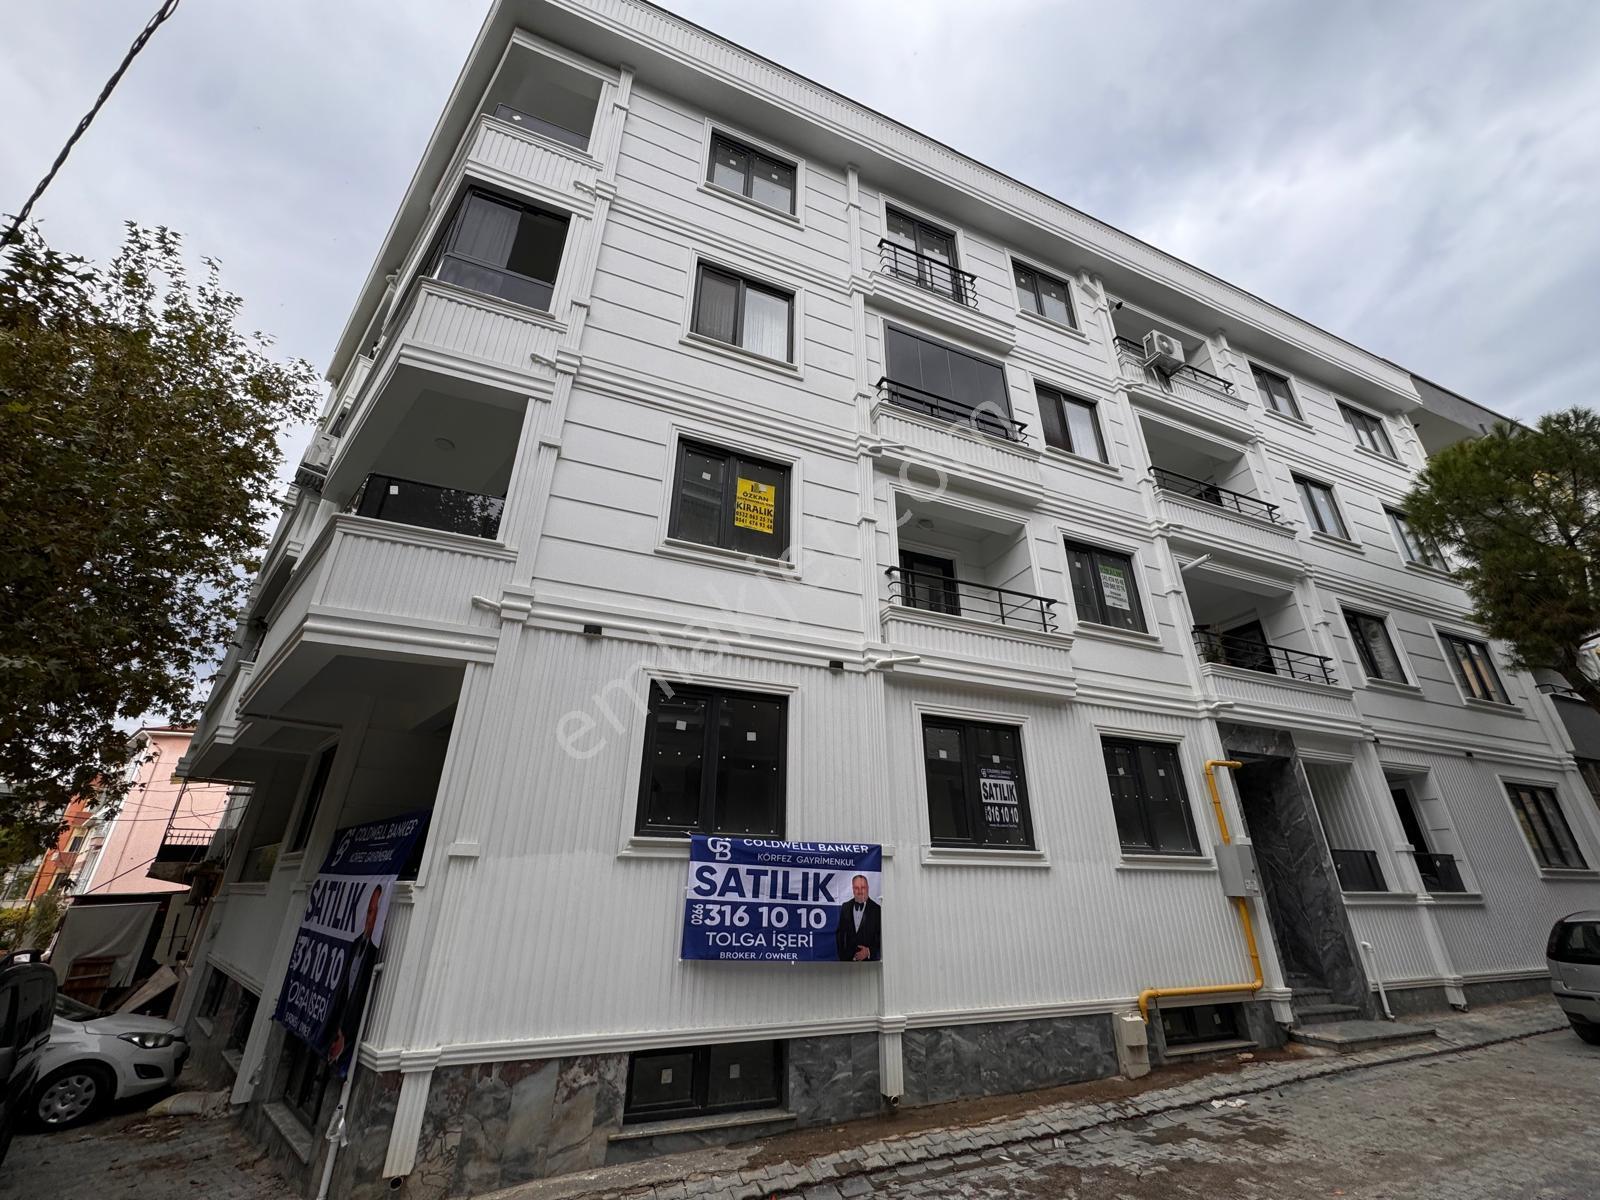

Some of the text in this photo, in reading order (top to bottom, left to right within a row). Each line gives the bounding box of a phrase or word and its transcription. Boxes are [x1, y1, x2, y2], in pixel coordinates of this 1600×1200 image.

[736, 501, 773, 517] KİRALIK
[982, 781, 1018, 802] SATILIK
[988, 805, 1000, 823] 316
[1001, 806, 1010, 823] 10
[1010, 806, 1019, 823] 10
[743, 838, 869, 854] COLDWELL BANKER
[757, 853, 856, 867] KÖRFEZ GAYRİMENKUL
[693, 865, 836, 903] SATILIK
[305, 879, 367, 933] SATILIK
[691, 903, 704, 925] 0266
[703, 904, 827, 929] 316 10 10
[706, 930, 814, 951] TOLGA İŞERİ
[310, 942, 329, 983] 10
[325, 946, 345, 991] 10
[719, 951, 757, 960] BROKER
[765, 952, 798, 961] OWNER
